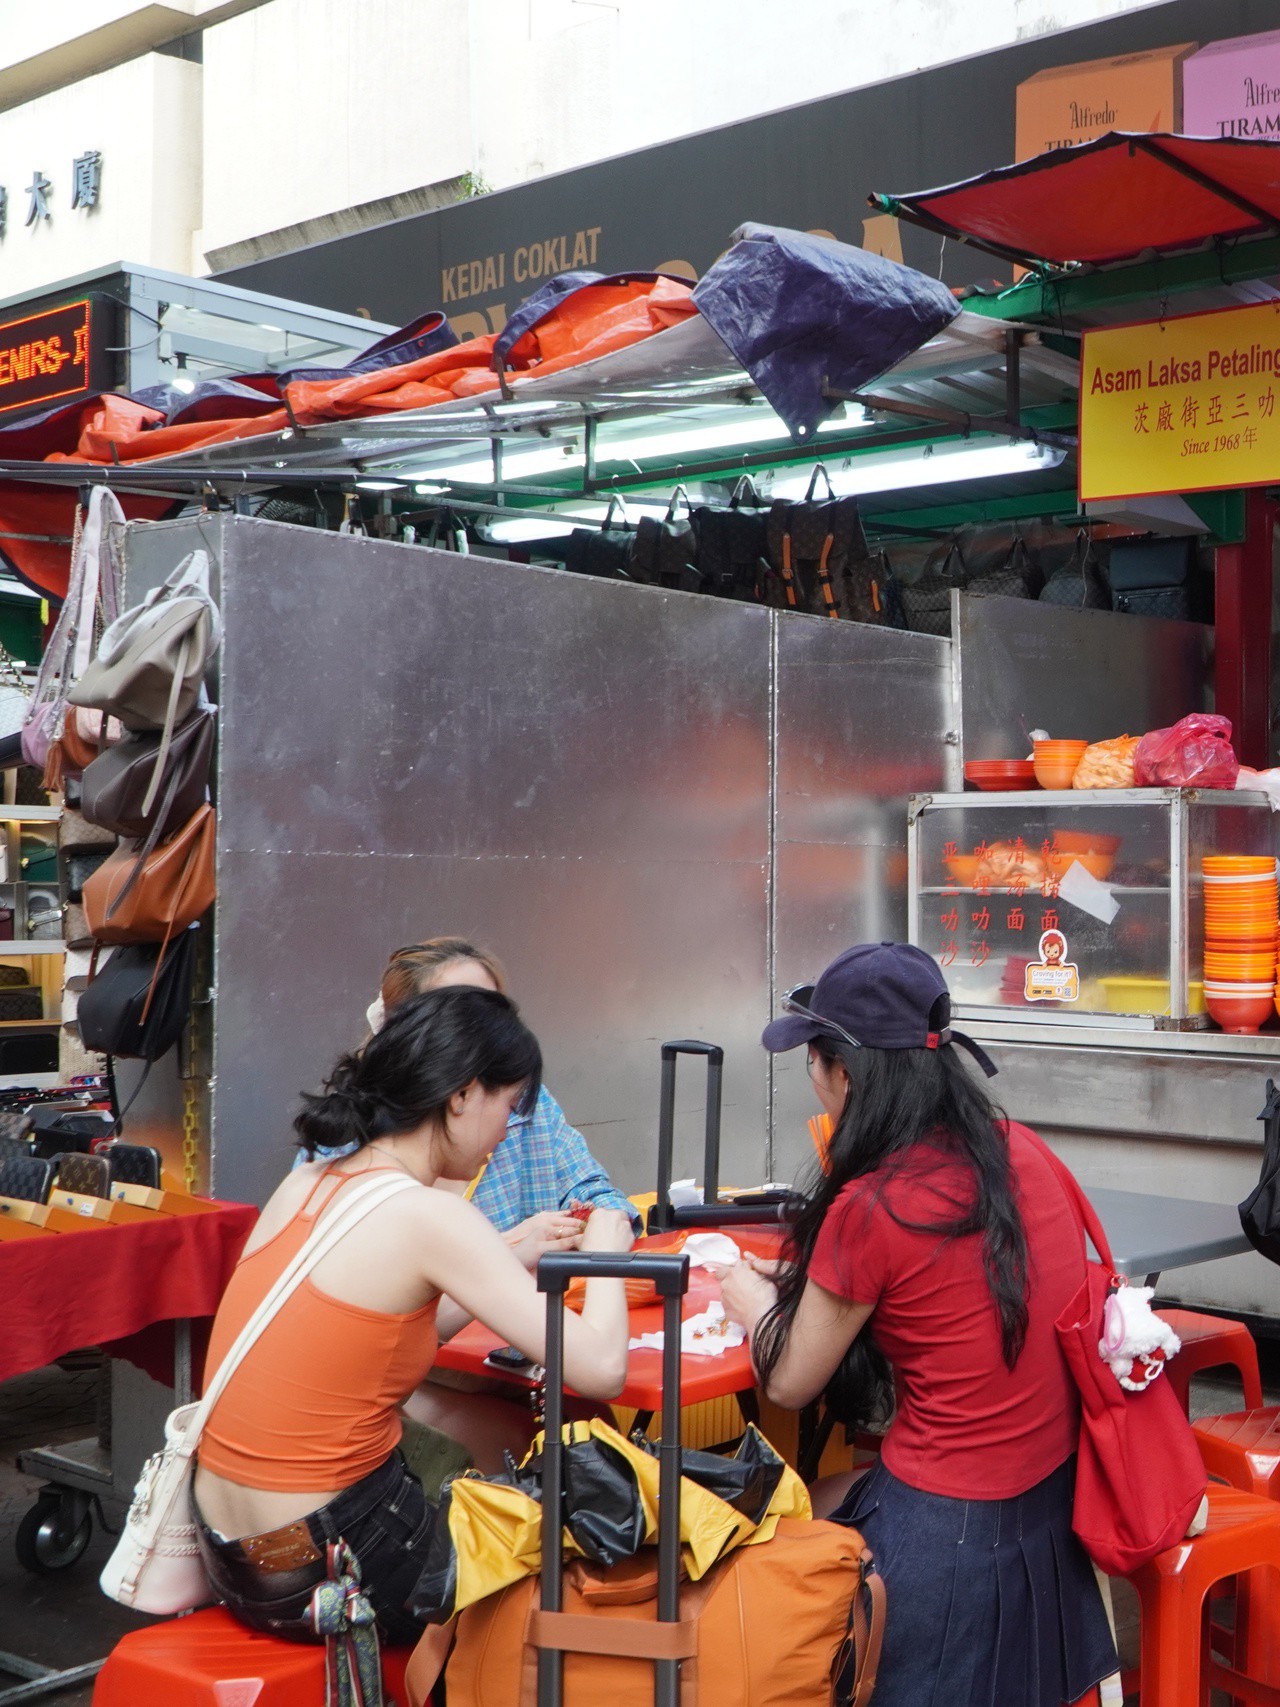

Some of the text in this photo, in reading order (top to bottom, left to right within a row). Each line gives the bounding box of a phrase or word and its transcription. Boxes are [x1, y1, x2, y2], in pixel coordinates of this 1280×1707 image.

[1069, 100, 1117, 130] Alfredo
[0, 150, 102, 238] 大廈
[442, 227, 602, 303] KEDAI COKLAT
[1091, 366, 1142, 395] Asam
[1147, 356, 1201, 388] Laksa
[1180, 439, 1210, 457] Since
[941, 841, 960, 967] 亚三叻沙
[971, 839, 994, 968] 咖哩叻沙
[1006, 836, 1028, 932] 清汤面
